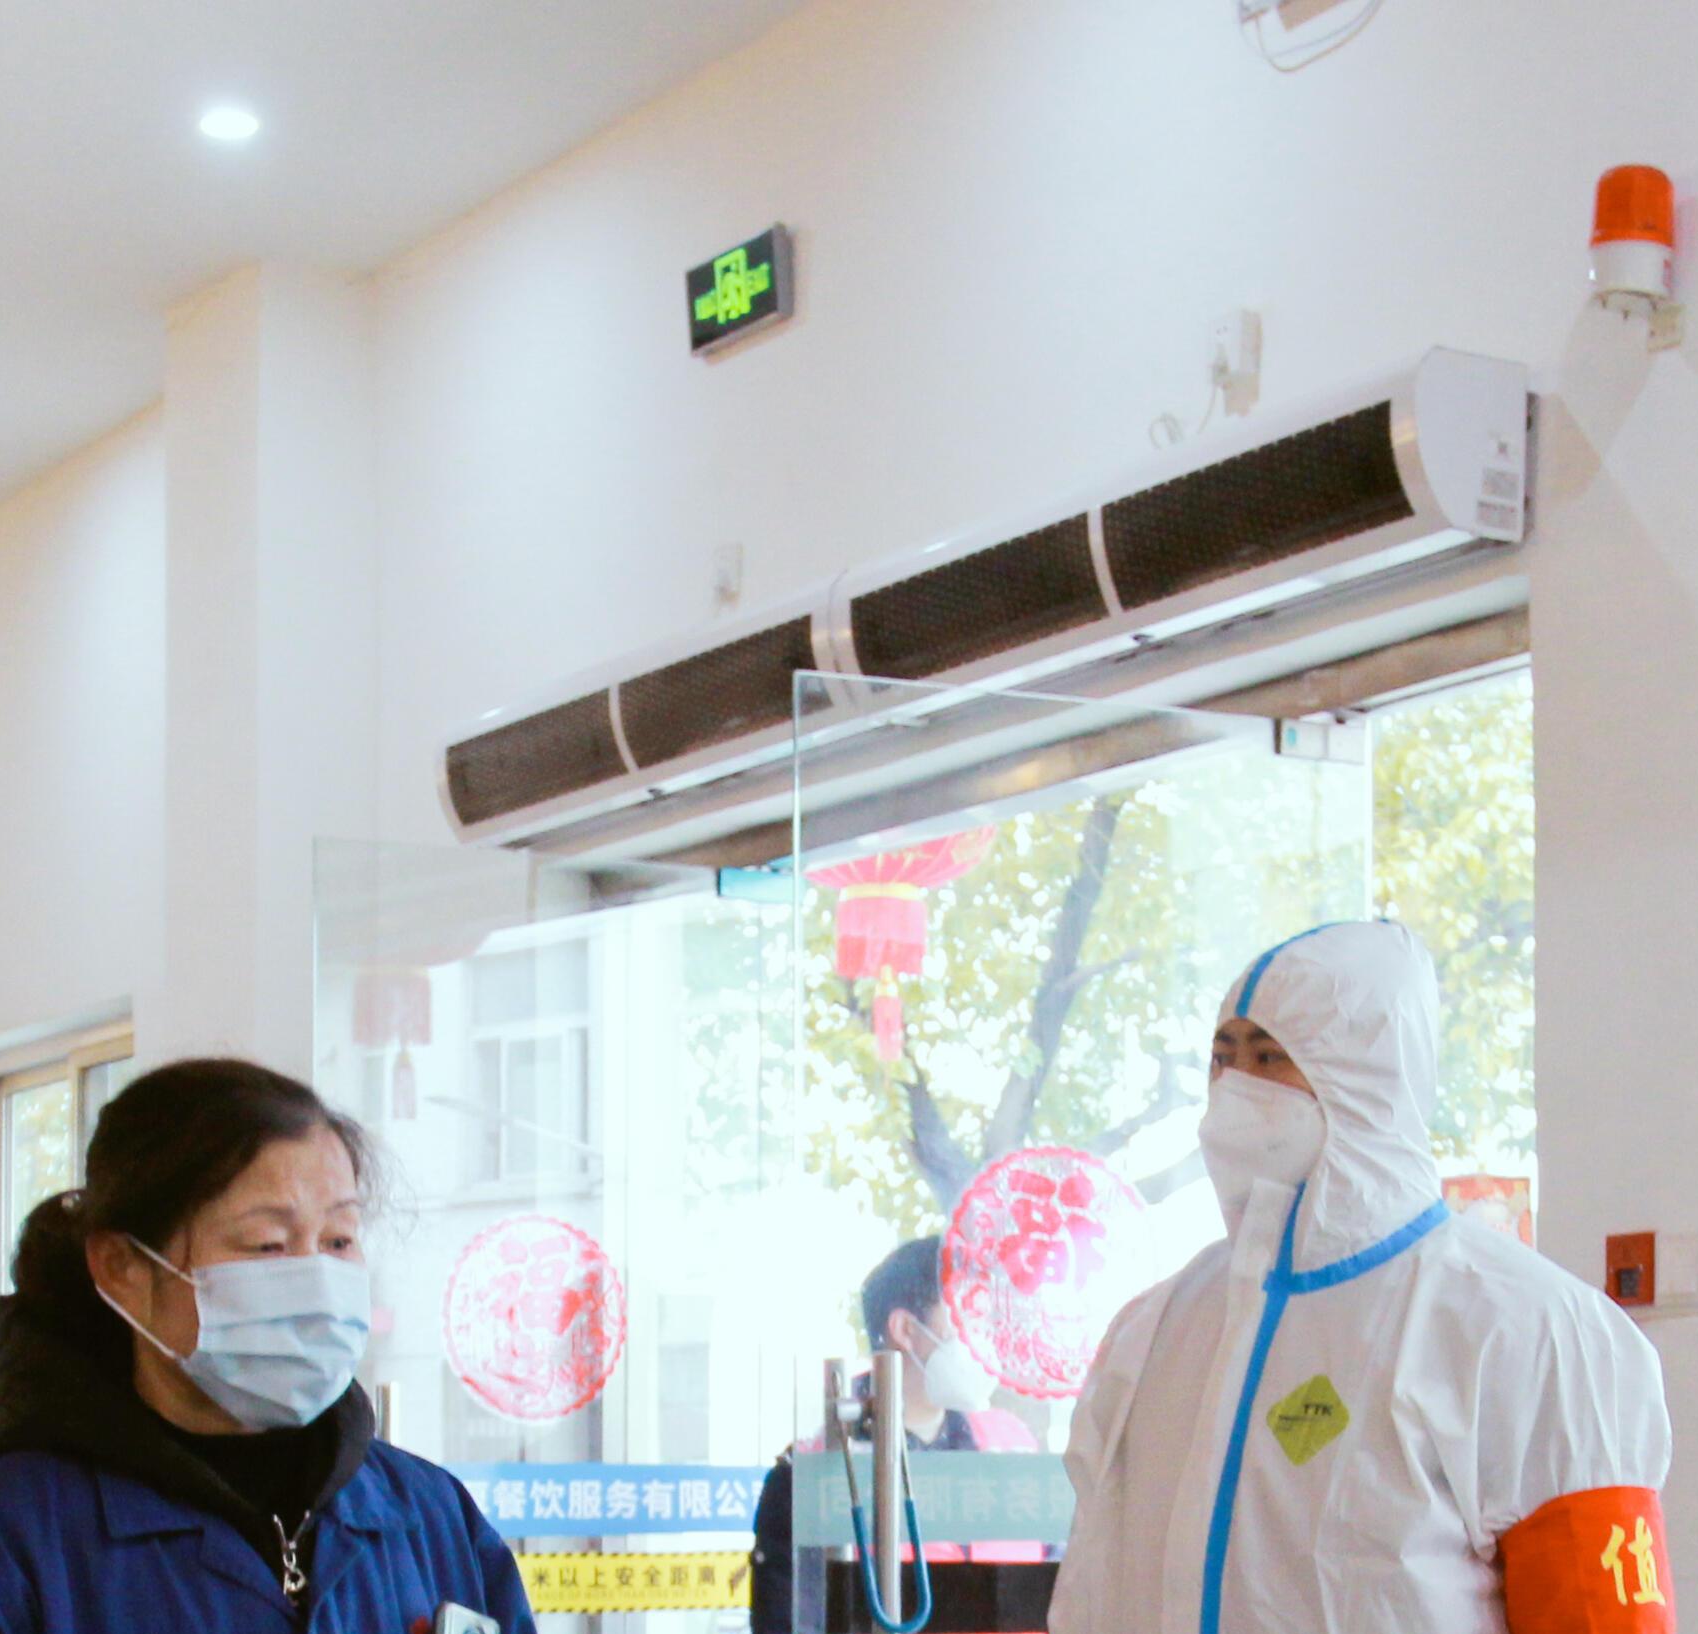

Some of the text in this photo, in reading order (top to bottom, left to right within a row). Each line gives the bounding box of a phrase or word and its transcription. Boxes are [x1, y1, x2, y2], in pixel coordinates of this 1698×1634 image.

[531, 1564, 716, 1587] 米以上安全距离
[1601, 1515, 1666, 1607] 值
